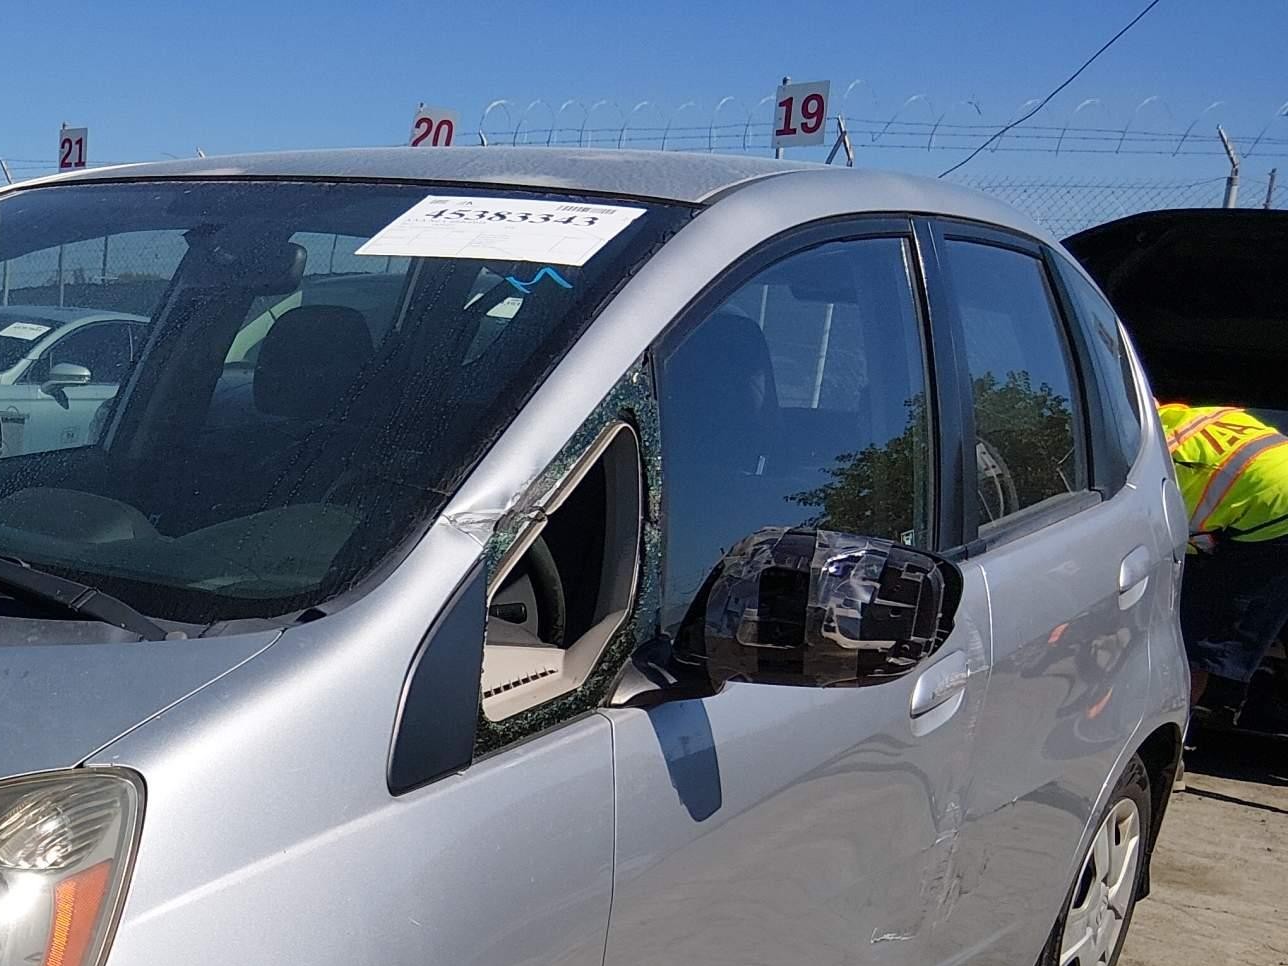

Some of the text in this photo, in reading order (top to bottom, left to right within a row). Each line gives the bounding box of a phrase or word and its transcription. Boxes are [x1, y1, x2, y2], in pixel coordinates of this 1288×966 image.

[776, 94, 824, 136] 19
[412, 117, 453, 147] 20
[61, 137, 85, 168] 21
[425, 208, 599, 227] 45383343
